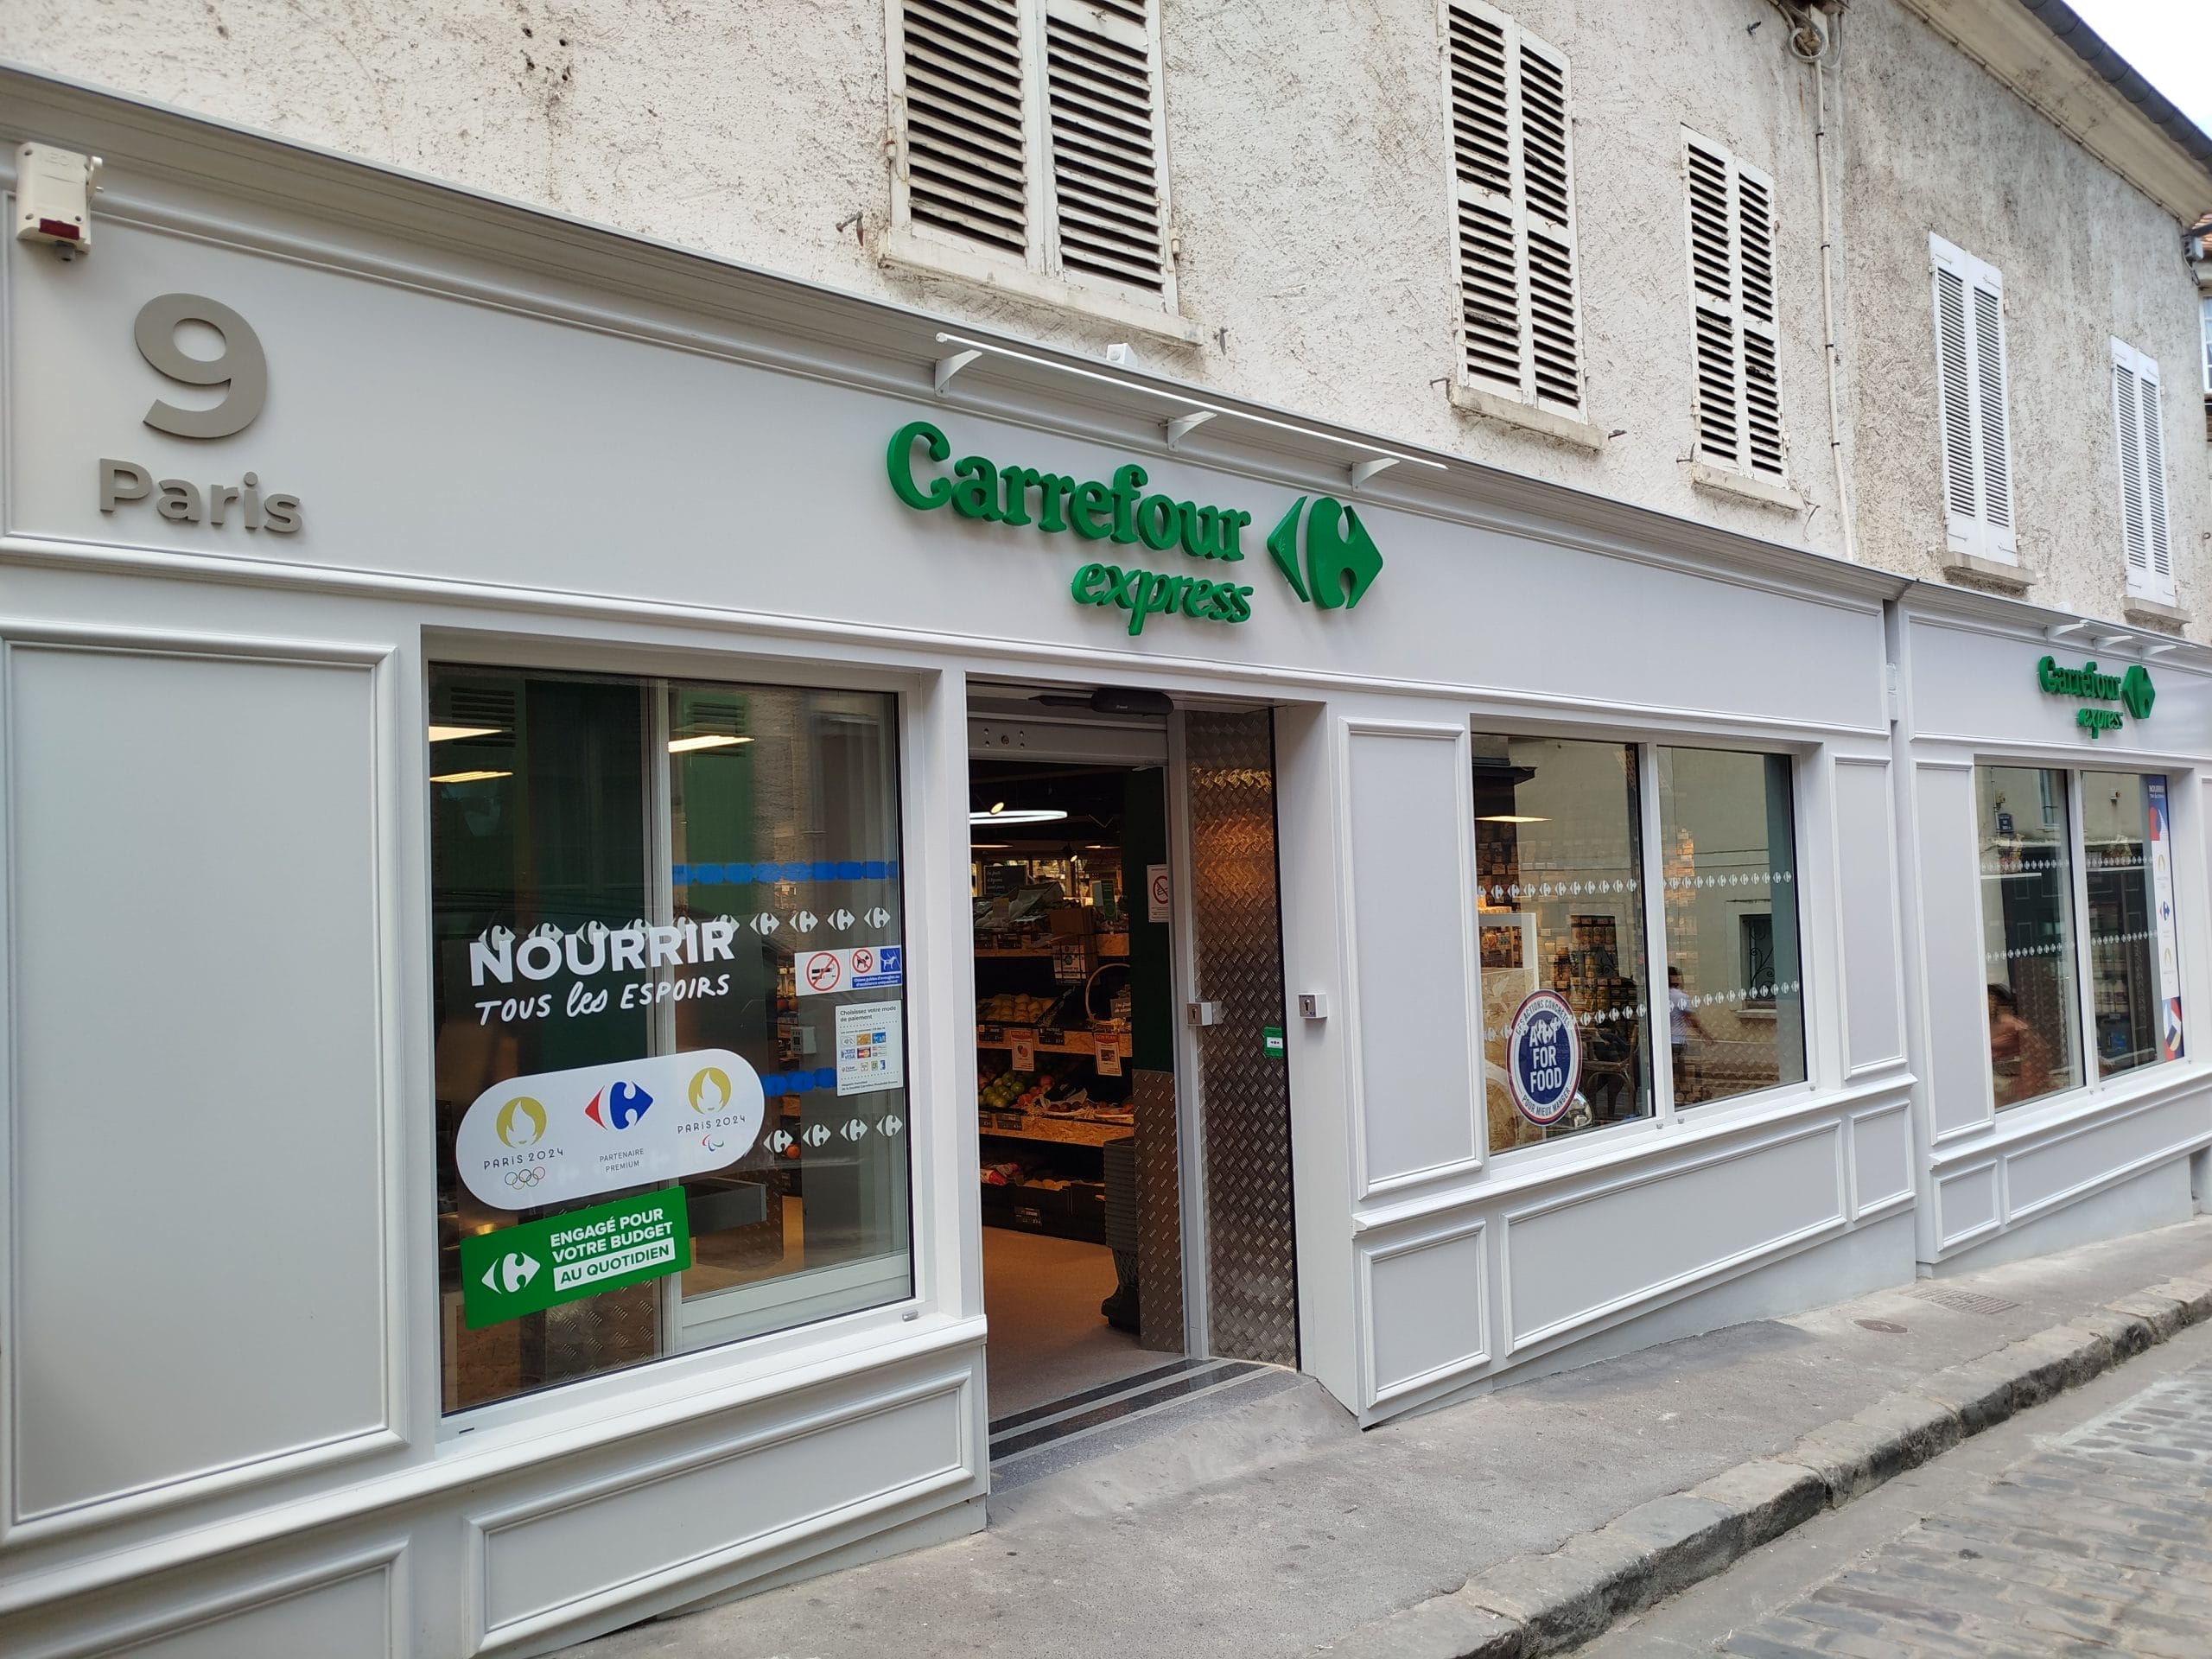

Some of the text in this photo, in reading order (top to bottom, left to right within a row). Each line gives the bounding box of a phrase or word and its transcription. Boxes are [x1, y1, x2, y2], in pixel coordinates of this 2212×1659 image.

[134, 293, 267, 439] 9
[100, 458, 302, 532] Paris
[887, 422, 1251, 562] Carrefour
[1071, 563, 1254, 636] express
[2038, 656, 2121, 701] Carrefour
[2077, 709, 2123, 739] express
[469, 922, 734, 987] NOURRIR
[475, 974, 730, 1027] TOUS les ESPOIRS
[1523, 1000, 1544, 1020] ACTIONS
[1533, 1046, 1557, 1070] FOR
[1530, 1067, 1562, 1093] FOOD
[715, 1114, 746, 1128] 2024
[1522, 1087, 1570, 1116] POUR MIEUX MANGER
[528, 1147, 564, 1162] 2024
[599, 1147, 645, 1163] PARTENAIRE
[606, 1160, 639, 1173] PREMIUM
[550, 1208, 664, 1248] ENGAGÉ POUR
[552, 1222, 673, 1263] VOTRE BUDGET
[560, 1244, 670, 1285] AU QUOTIDIEN
